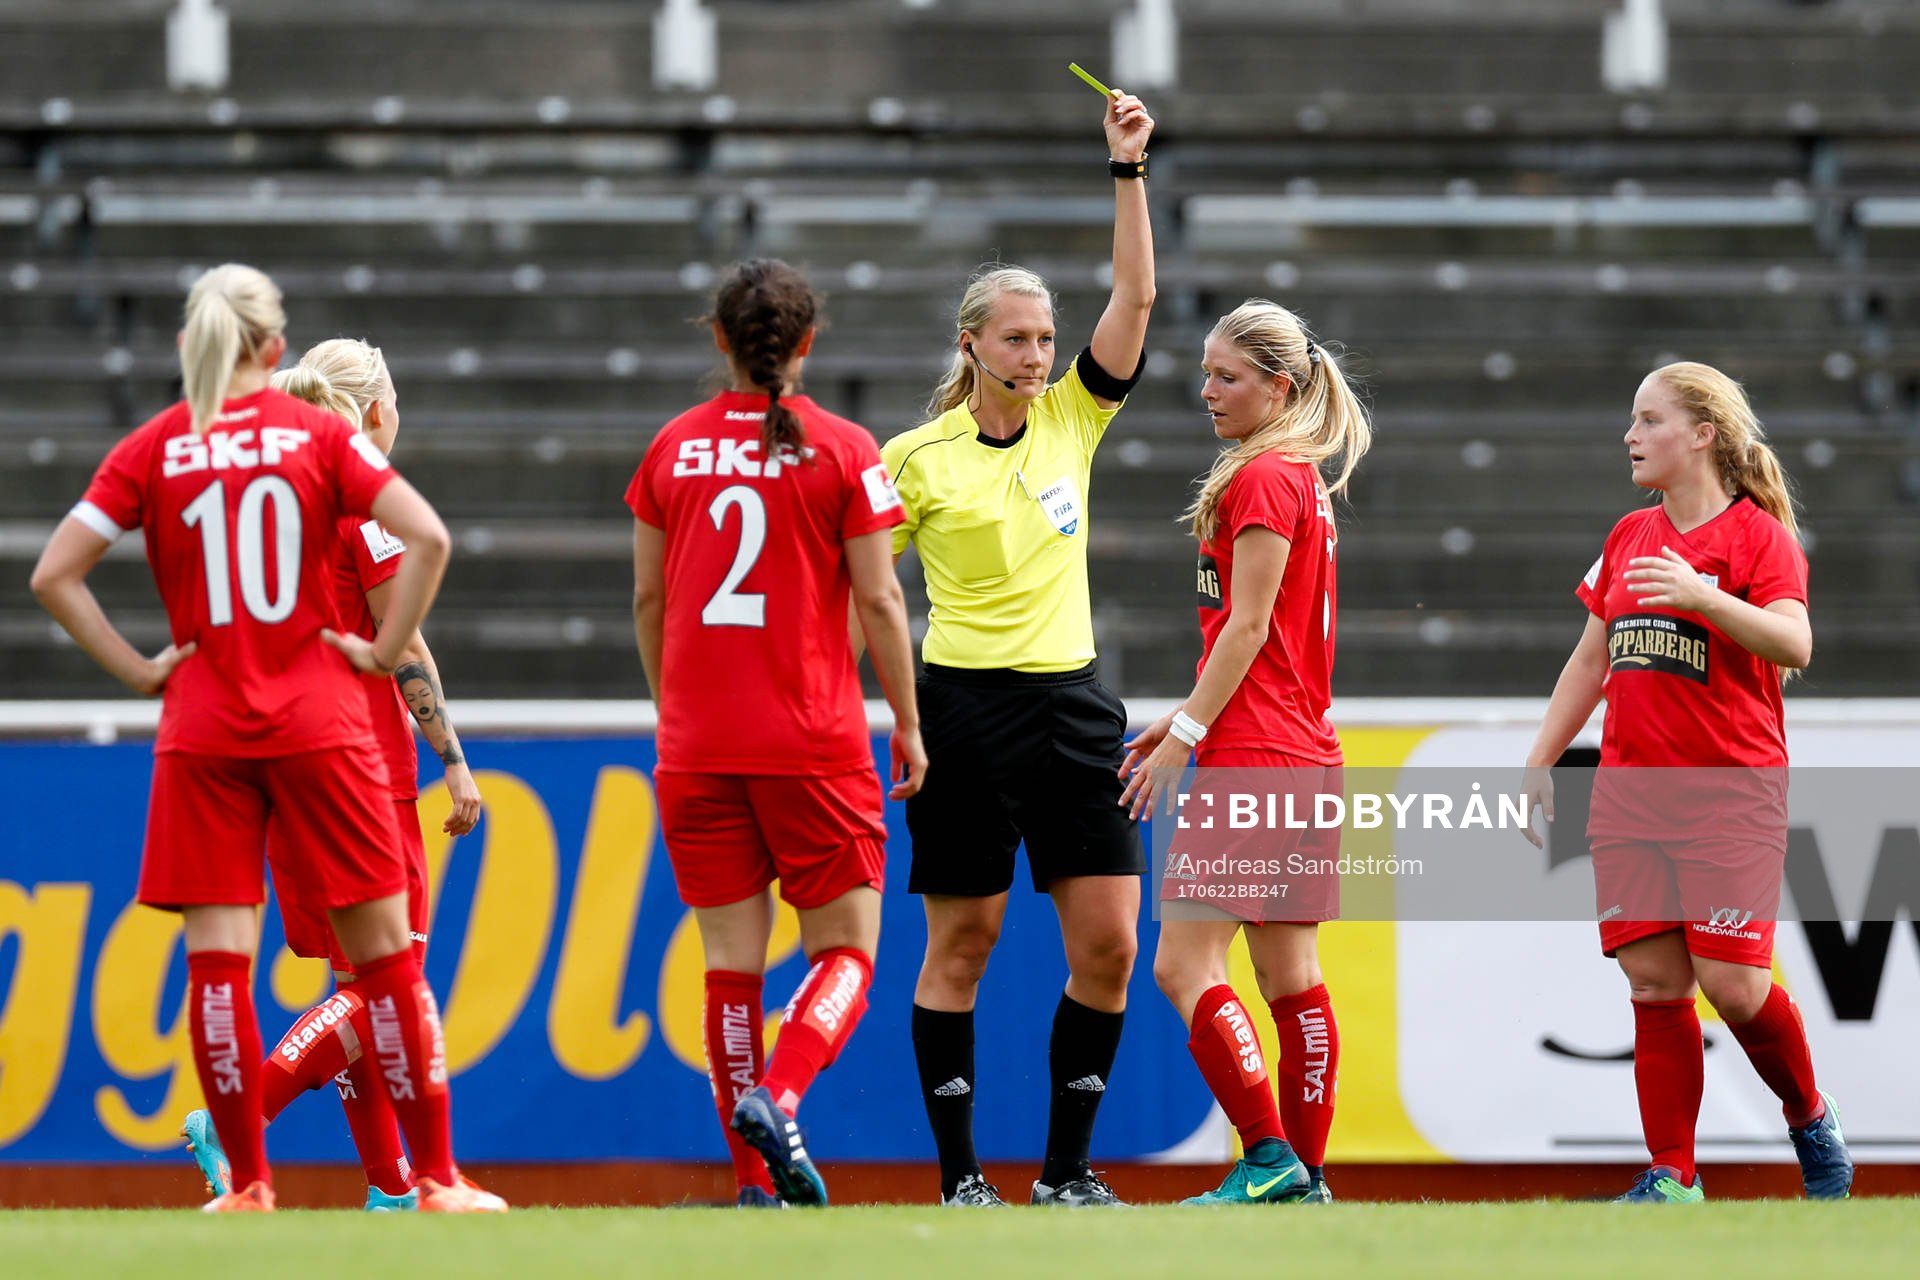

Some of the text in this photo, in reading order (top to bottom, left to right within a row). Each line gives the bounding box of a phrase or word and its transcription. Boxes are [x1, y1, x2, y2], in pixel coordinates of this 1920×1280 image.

[162, 427, 311, 479] SKF
[1054, 502, 1073, 518] FIFA
[181, 474, 302, 627] 10
[701, 484, 767, 627] 2
[1609, 629, 1706, 672] PPARBERG
[1615, 619, 1677, 631] PREMIUM CIDER
[281, 995, 353, 1062] Stavdal
